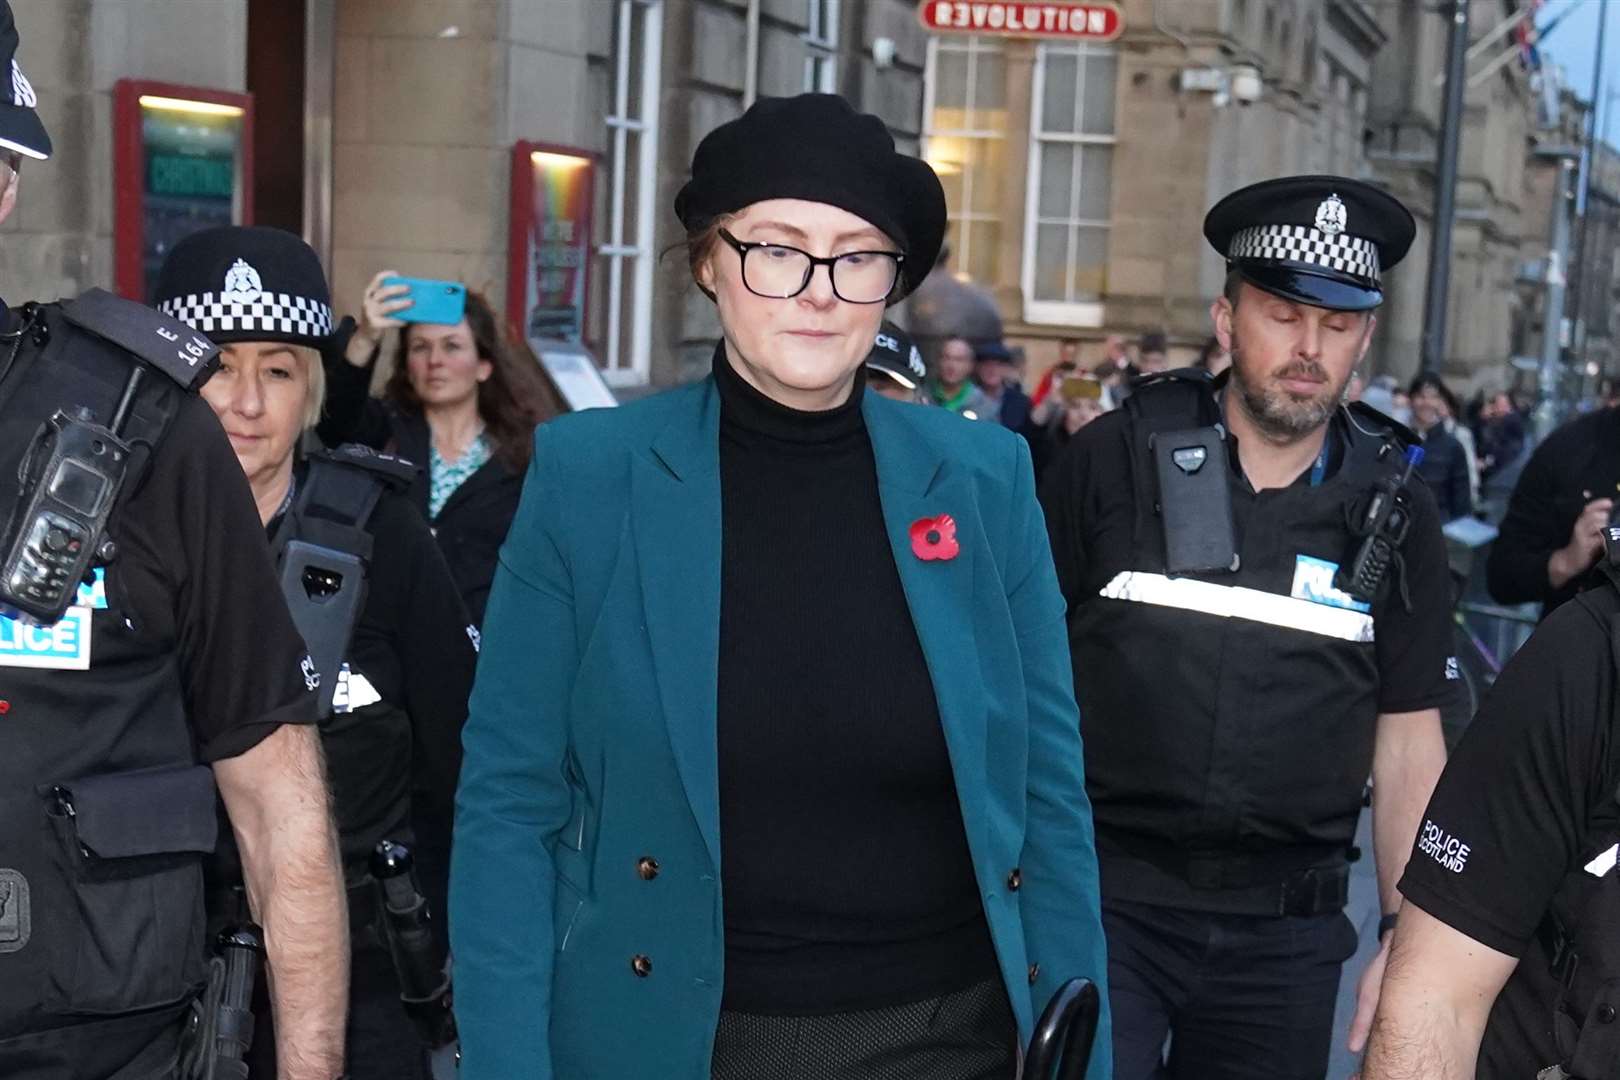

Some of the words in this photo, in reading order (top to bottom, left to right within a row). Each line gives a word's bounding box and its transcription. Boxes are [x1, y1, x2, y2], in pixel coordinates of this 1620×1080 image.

[156, 327, 179, 342] E
[177, 336, 211, 367] 164
[1423, 820, 1471, 862] POLICE
